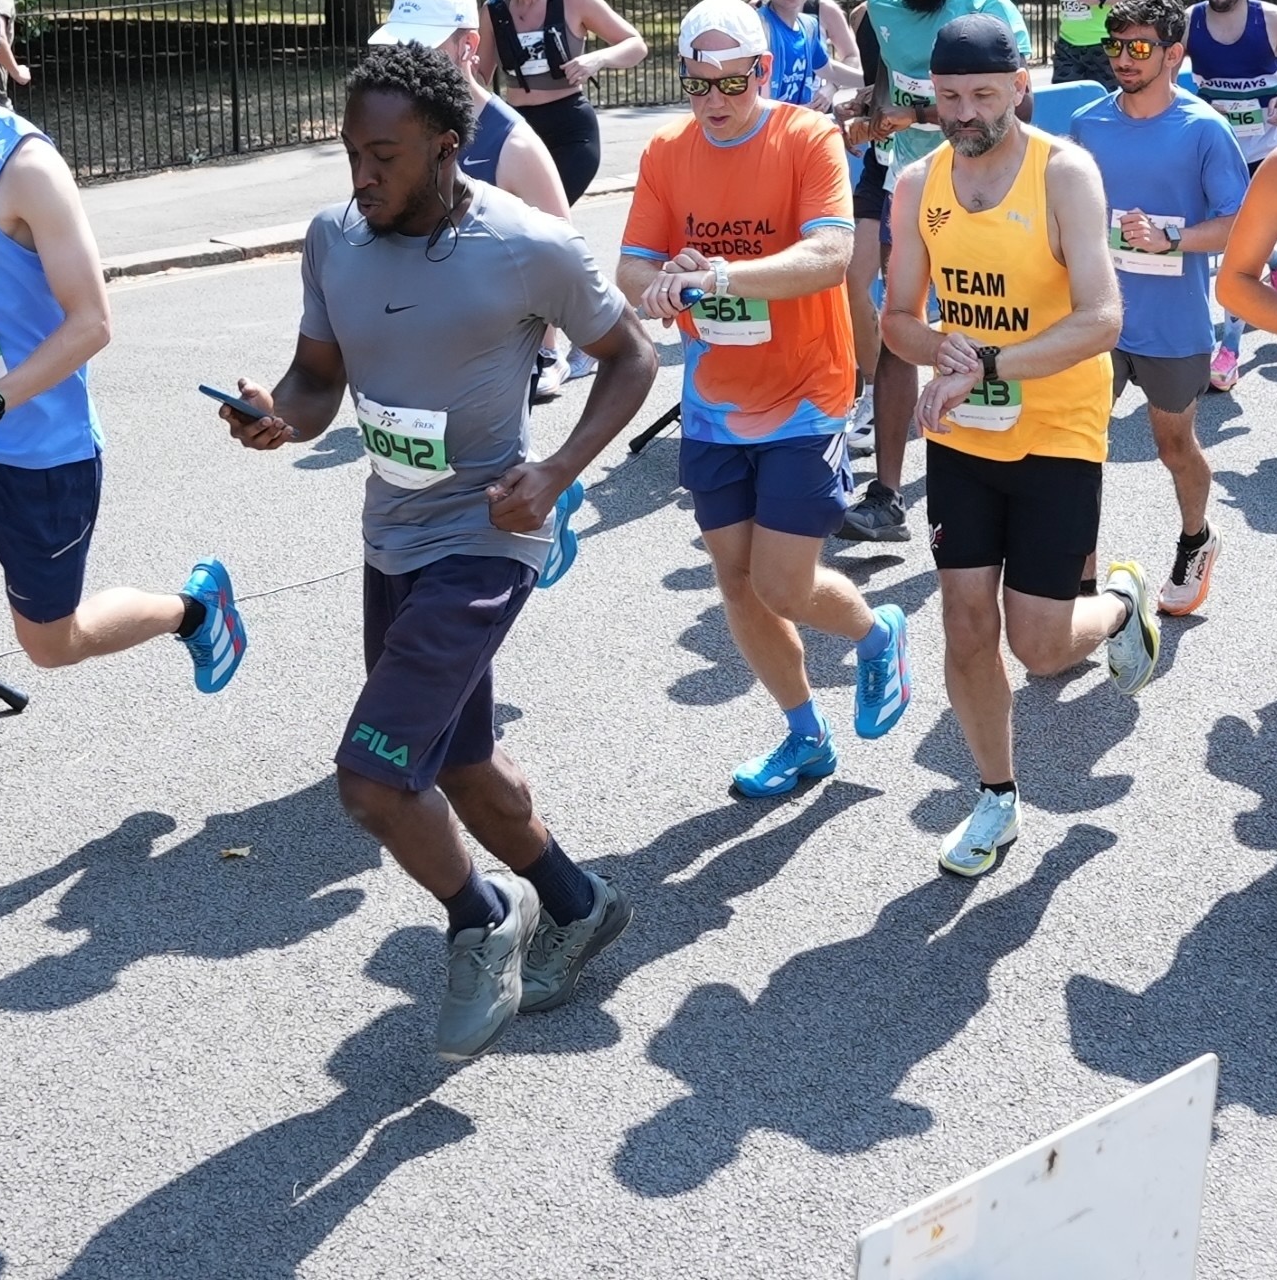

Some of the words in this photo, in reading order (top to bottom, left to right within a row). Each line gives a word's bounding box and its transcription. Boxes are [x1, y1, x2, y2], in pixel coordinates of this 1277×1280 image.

[1200, 78, 1267, 90] OURWAYS
[695, 218, 776, 238] COASTAL
[941, 267, 1005, 298] TEAM
[699, 296, 752, 322] 561
[963, 379, 1010, 406] 43
[362, 423, 437, 470] 1042
[1196, 551, 1208, 581] HOKA
[351, 723, 409, 767] FILA
